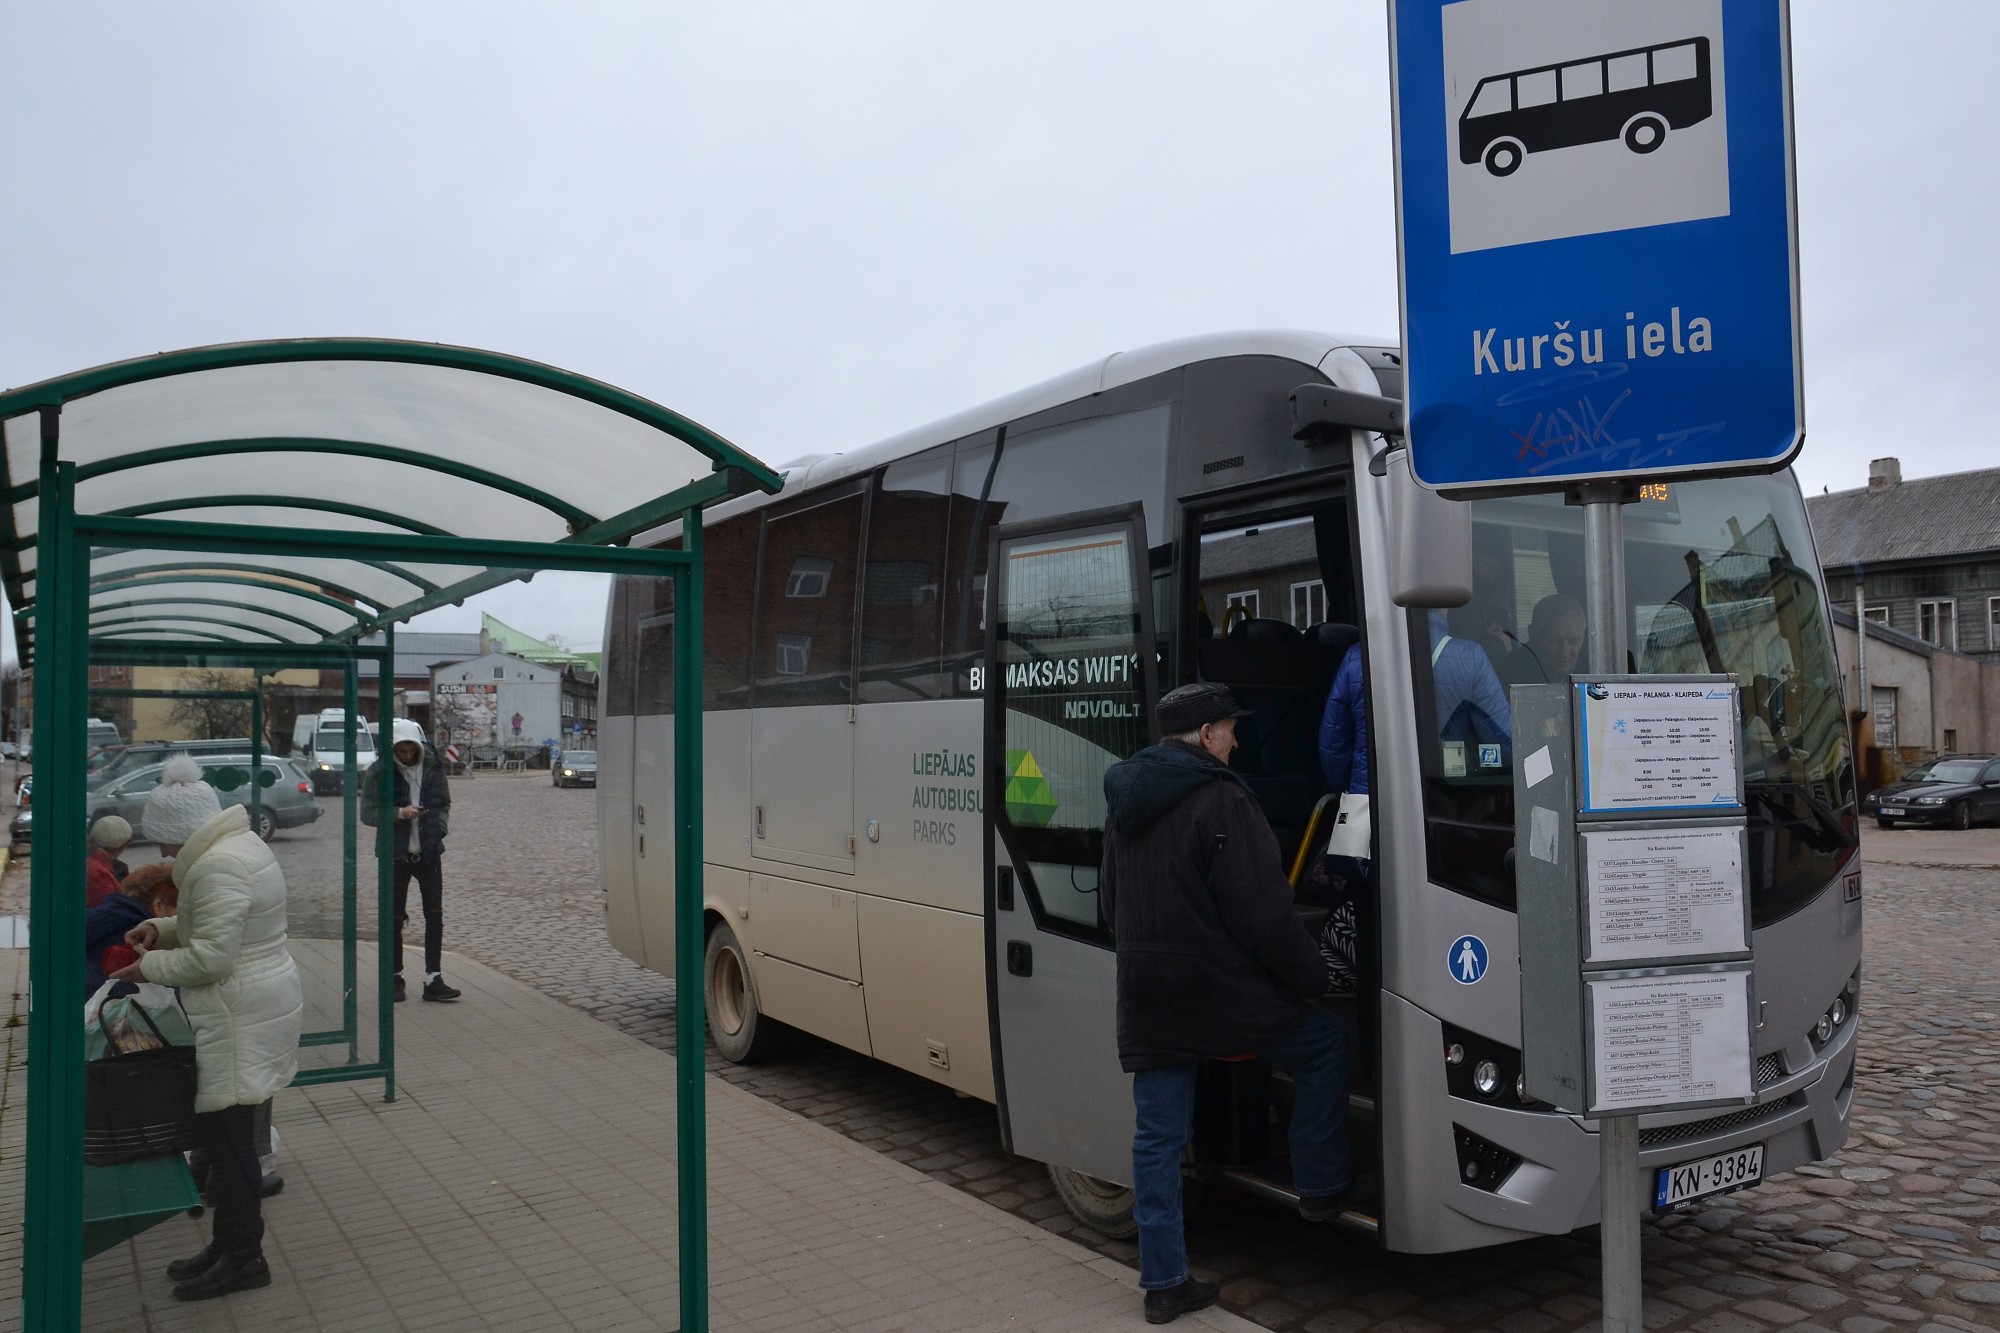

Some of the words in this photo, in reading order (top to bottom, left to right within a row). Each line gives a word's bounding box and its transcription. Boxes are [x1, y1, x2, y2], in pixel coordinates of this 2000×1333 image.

[1473, 321, 1604, 375] Kuršu
[1625, 306, 1714, 360] iela
[1084, 654, 1128, 684] WIFI
[440, 685, 466, 693] SUSHI
[913, 748, 976, 778] LIEPĀJAS
[912, 786, 984, 813] AUTOBUSU
[913, 820, 956, 846] PARKS
[1672, 1150, 1758, 1198] KN-9384
[1658, 1191, 1667, 1200] LV
[1674, 1200, 1691, 1210] ISUZU
